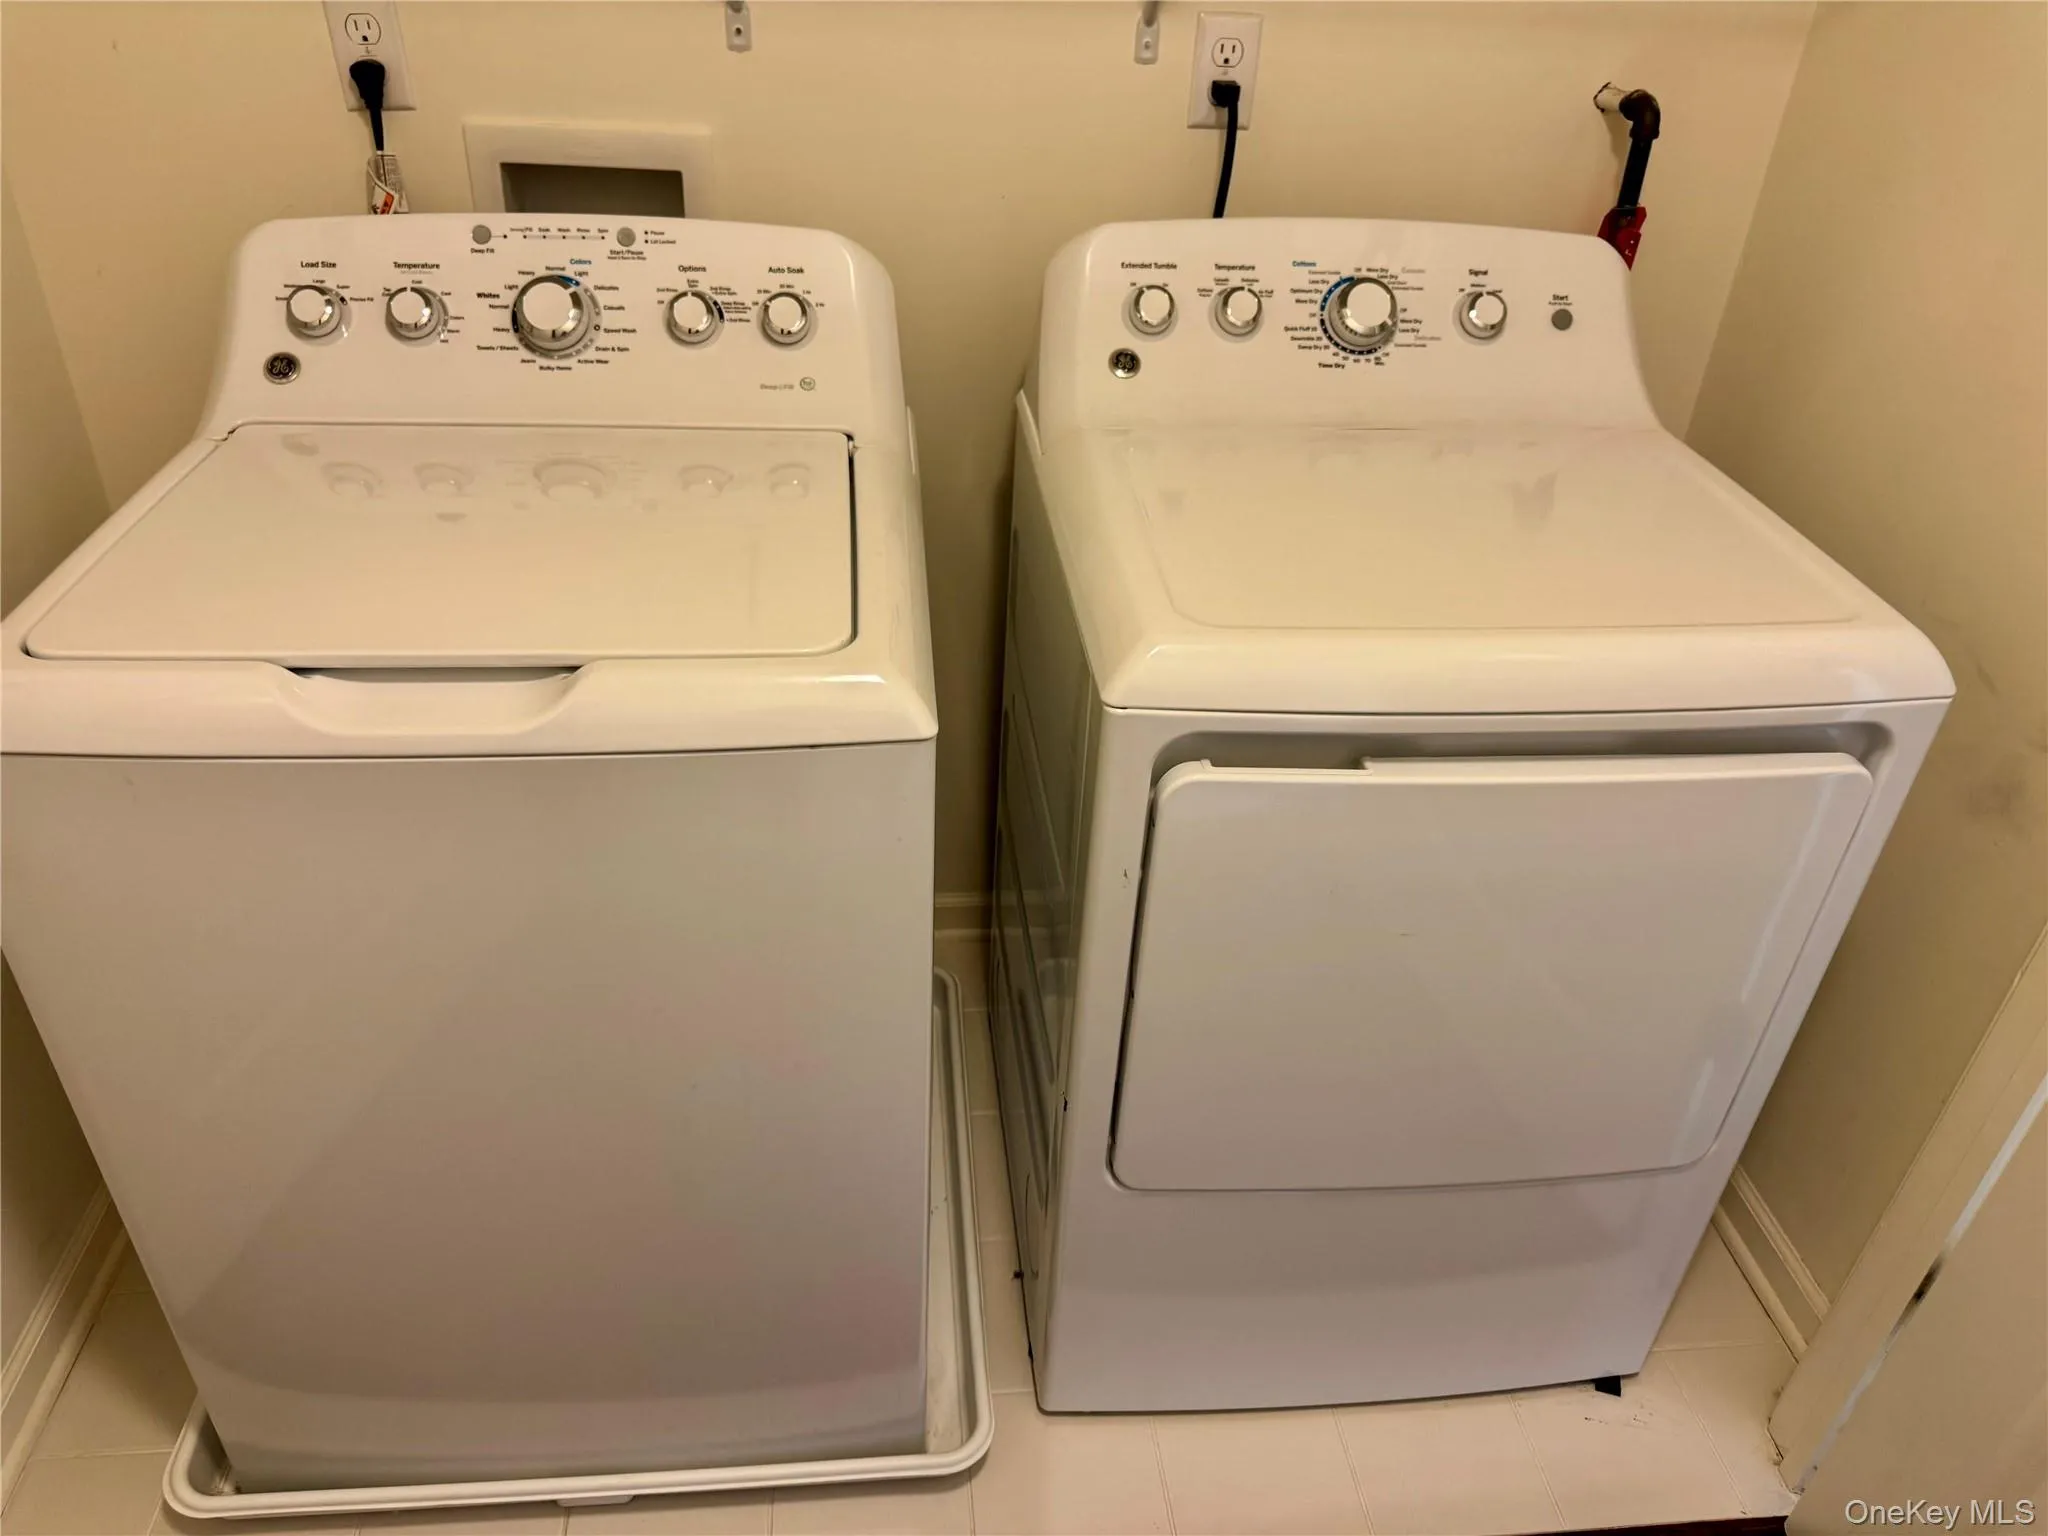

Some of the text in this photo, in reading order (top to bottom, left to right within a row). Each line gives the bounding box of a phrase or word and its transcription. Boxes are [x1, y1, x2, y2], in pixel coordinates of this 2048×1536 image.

[320, 261, 337, 269] Size
[393, 261, 440, 270] Temperature
[678, 265, 707, 273] Options
[1153, 262, 1177, 270] Tumble
[1214, 263, 1255, 271] Temperature
[1468, 269, 1488, 277] Signal
